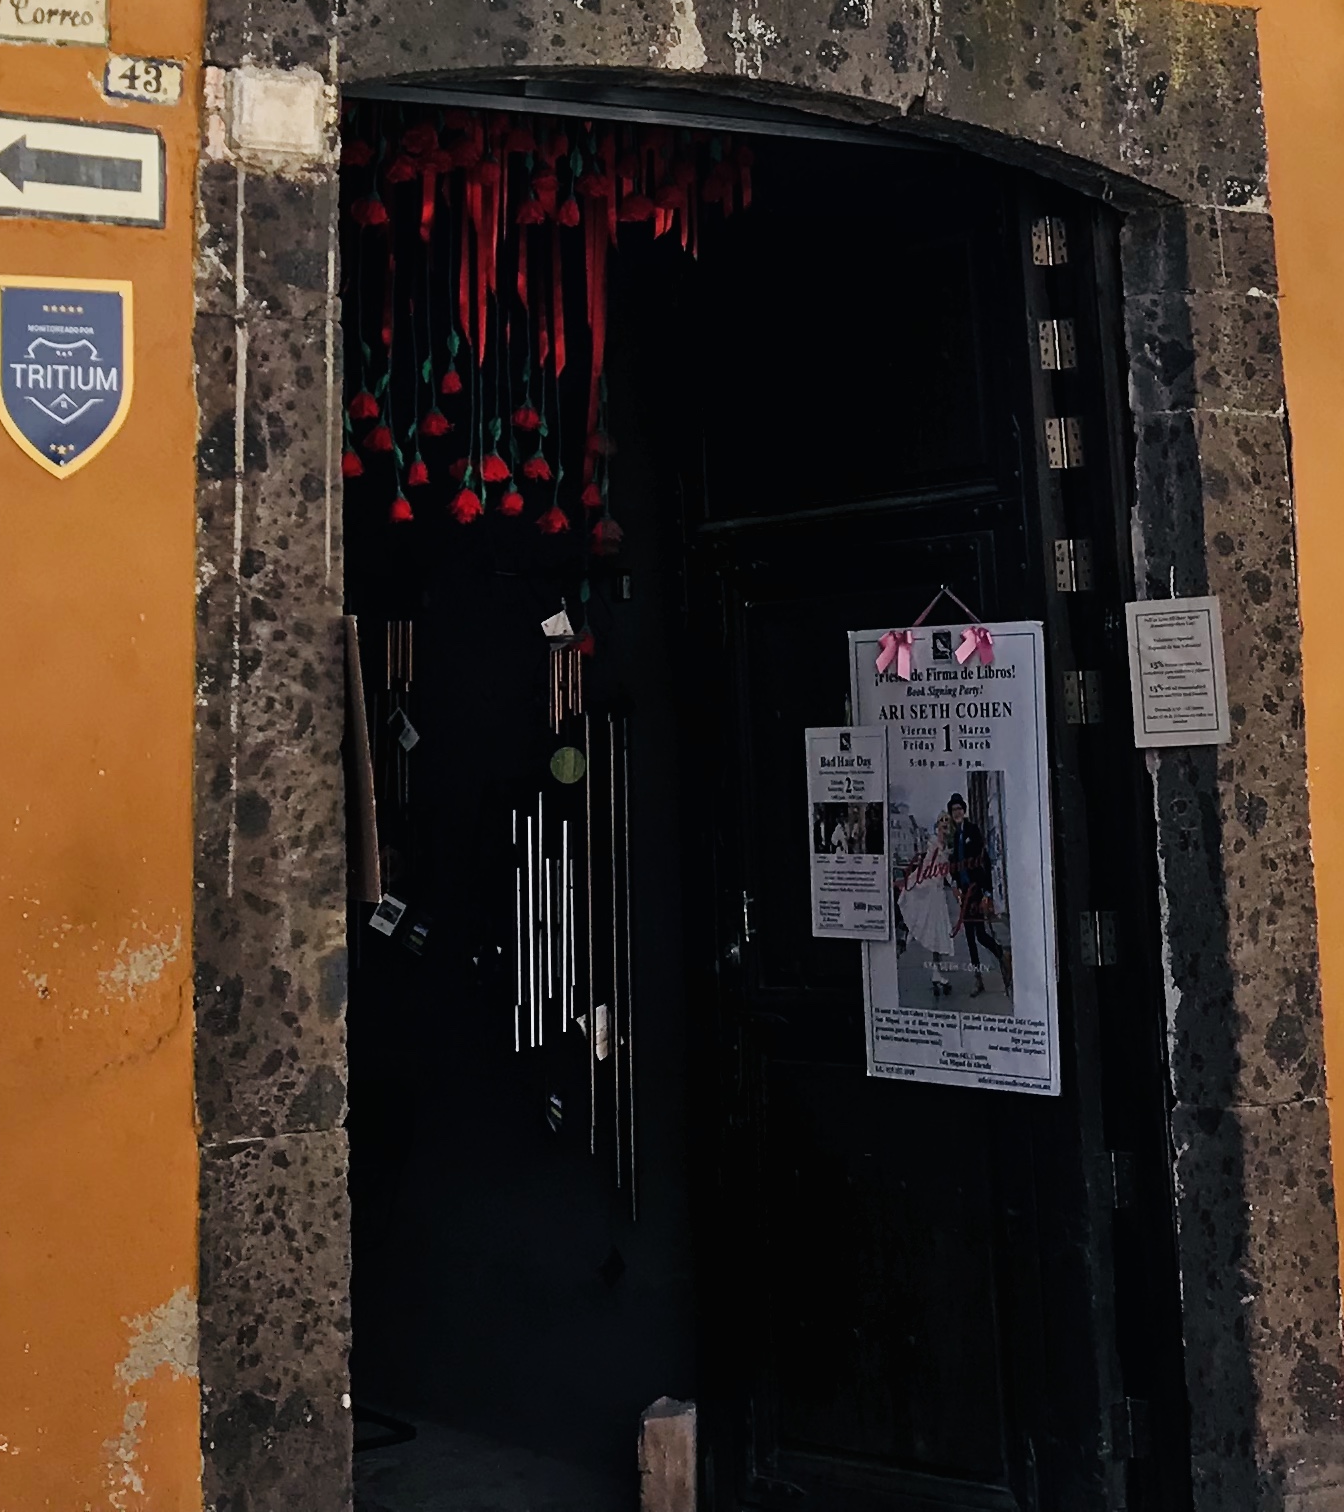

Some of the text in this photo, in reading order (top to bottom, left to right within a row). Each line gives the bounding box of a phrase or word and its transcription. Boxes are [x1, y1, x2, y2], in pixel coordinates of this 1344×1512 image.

[9, 363, 119, 392] TRITIUM
[911, 668, 923, 682] de
[926, 666, 959, 682] Firma
[960, 667, 974, 681] de
[976, 664, 1016, 680] Libros!
[906, 684, 984, 698] Book Signing Party!
[878, 701, 1013, 720] ARI SETH COHEN
[900, 724, 992, 752] Viernes 1 Marzo
[903, 739, 991, 753] Friday March
[820, 755, 872, 769] Bad Hair Day
[845, 776, 853, 794] 2
